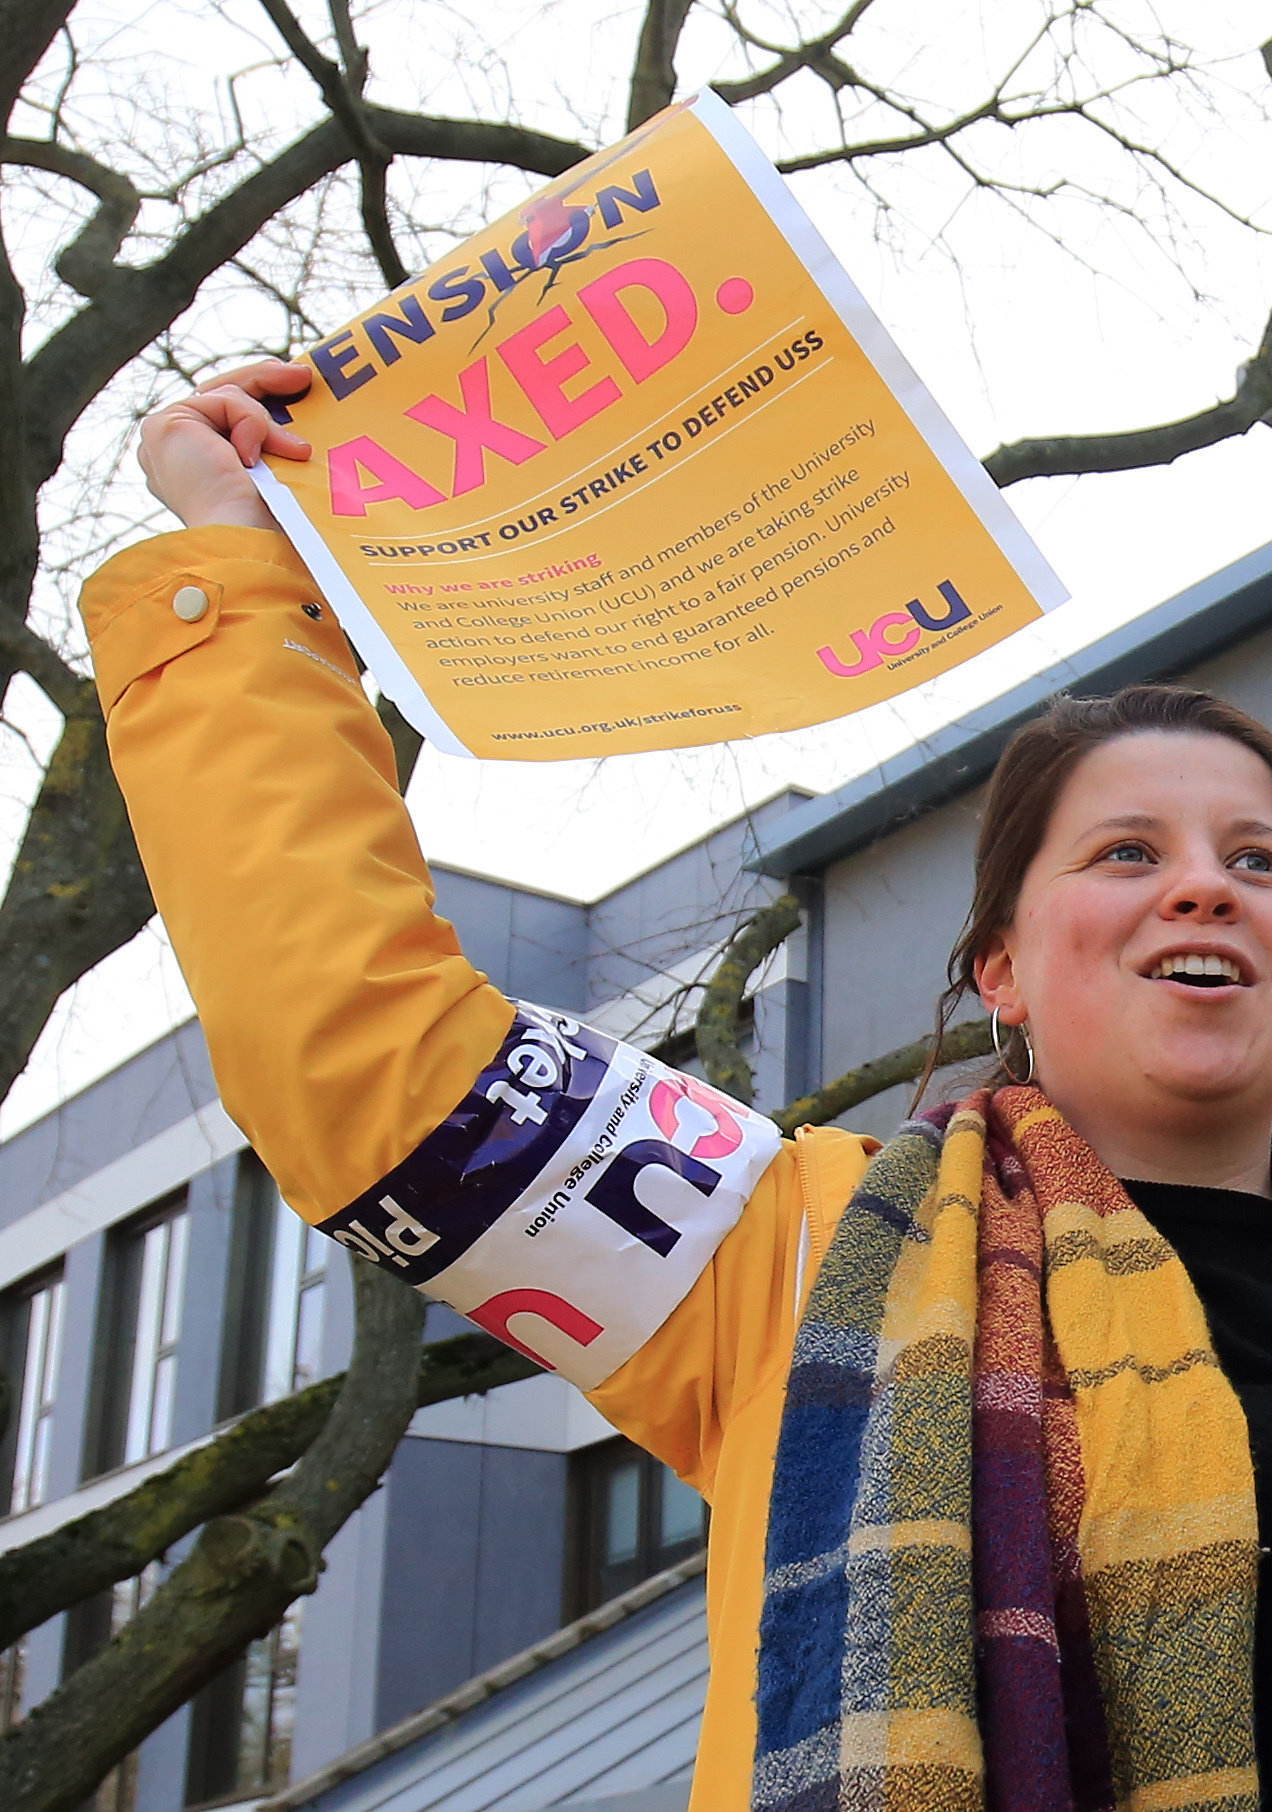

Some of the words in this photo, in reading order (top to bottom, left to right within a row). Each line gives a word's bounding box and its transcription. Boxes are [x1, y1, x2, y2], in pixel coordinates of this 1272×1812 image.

[327, 257, 755, 518] AXED.
[360, 531, 491, 558] SUPPORT
[499, 507, 559, 541] OUR
[560, 453, 649, 515] STRIKE
[646, 431, 682, 460] TO
[682, 364, 775, 438] DEFEND
[776, 330, 825, 371] USS
[397, 601, 433, 612] We
[438, 600, 468, 610] are
[473, 590, 570, 609] university
[573, 571, 614, 595] staff
[620, 553, 654, 580] and
[657, 510, 741, 563] members
[742, 492, 760, 514] of
[760, 476, 792, 502] the
[791, 418, 876, 480] University
[384, 583, 434, 596] Why
[440, 581, 473, 592] we
[478, 578, 512, 590] are
[517, 553, 602, 586] striking
[413, 616, 451, 631] and
[456, 615, 532, 629] College
[535, 606, 596, 625] Union
[599, 584, 657, 615] (UCU)
[659, 566, 695, 593] and
[697, 554, 725, 573] we
[727, 537, 757, 559] are
[756, 499, 815, 544] taking
[812, 467, 860, 506] strike
[426, 636, 490, 650] action
[493, 633, 517, 646] to
[520, 627, 590, 645] defend
[592, 622, 629, 637] our
[630, 602, 678, 631] right
[680, 594, 700, 610] to
[703, 589, 717, 602] a
[716, 572, 747, 596] fair
[750, 529, 827, 581] pension.
[824, 469, 911, 533] University
[438, 651, 549, 668] employers
[550, 644, 603, 661] want
[605, 640, 627, 654] to
[631, 633, 668, 654] end
[672, 596, 779, 649] guaranteed
[782, 540, 860, 599] pensions
[863, 516, 896, 548] and
[452, 672, 525, 688] reduce
[529, 663, 637, 682] retirement
[641, 651, 711, 672] income
[712, 636, 740, 659] for
[746, 623, 775, 648] all.
[887, 644, 930, 671] University
[931, 636, 947, 649] and
[947, 619, 979, 639] College
[979, 604, 1003, 621] Union
[491, 702, 742, 741] www.ucu.org.uk/strikeforuss
[604, 1106, 627, 1137] and
[564, 1133, 613, 1192] College
[524, 1188, 571, 1240] Union
